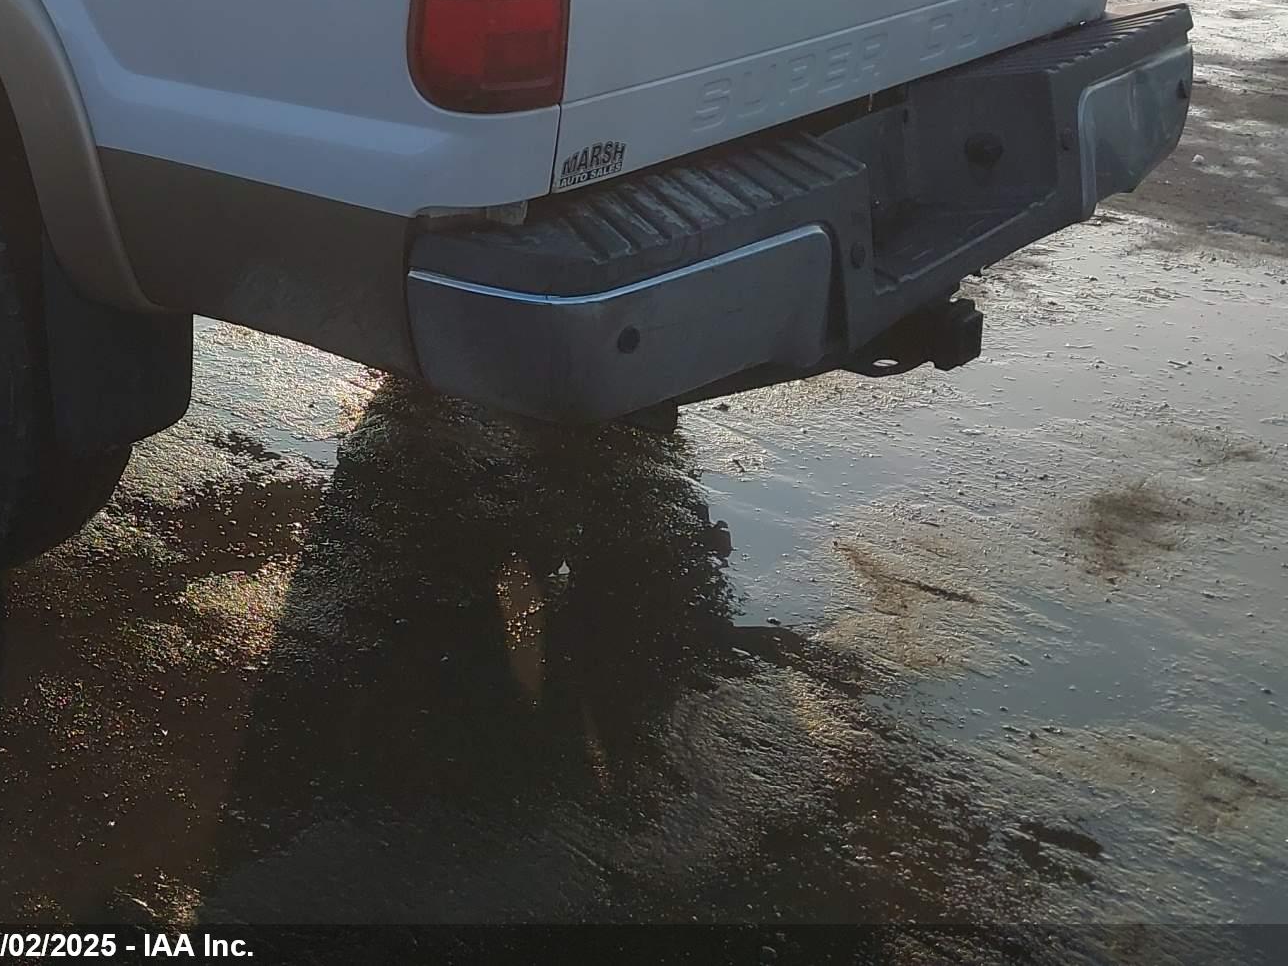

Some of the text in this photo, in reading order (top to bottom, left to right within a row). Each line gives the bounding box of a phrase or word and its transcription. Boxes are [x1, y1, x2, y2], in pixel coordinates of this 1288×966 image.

[691, 33, 888, 132] SUPER
[562, 140, 626, 174] MARSH
[560, 164, 622, 187] AUTO SALES
